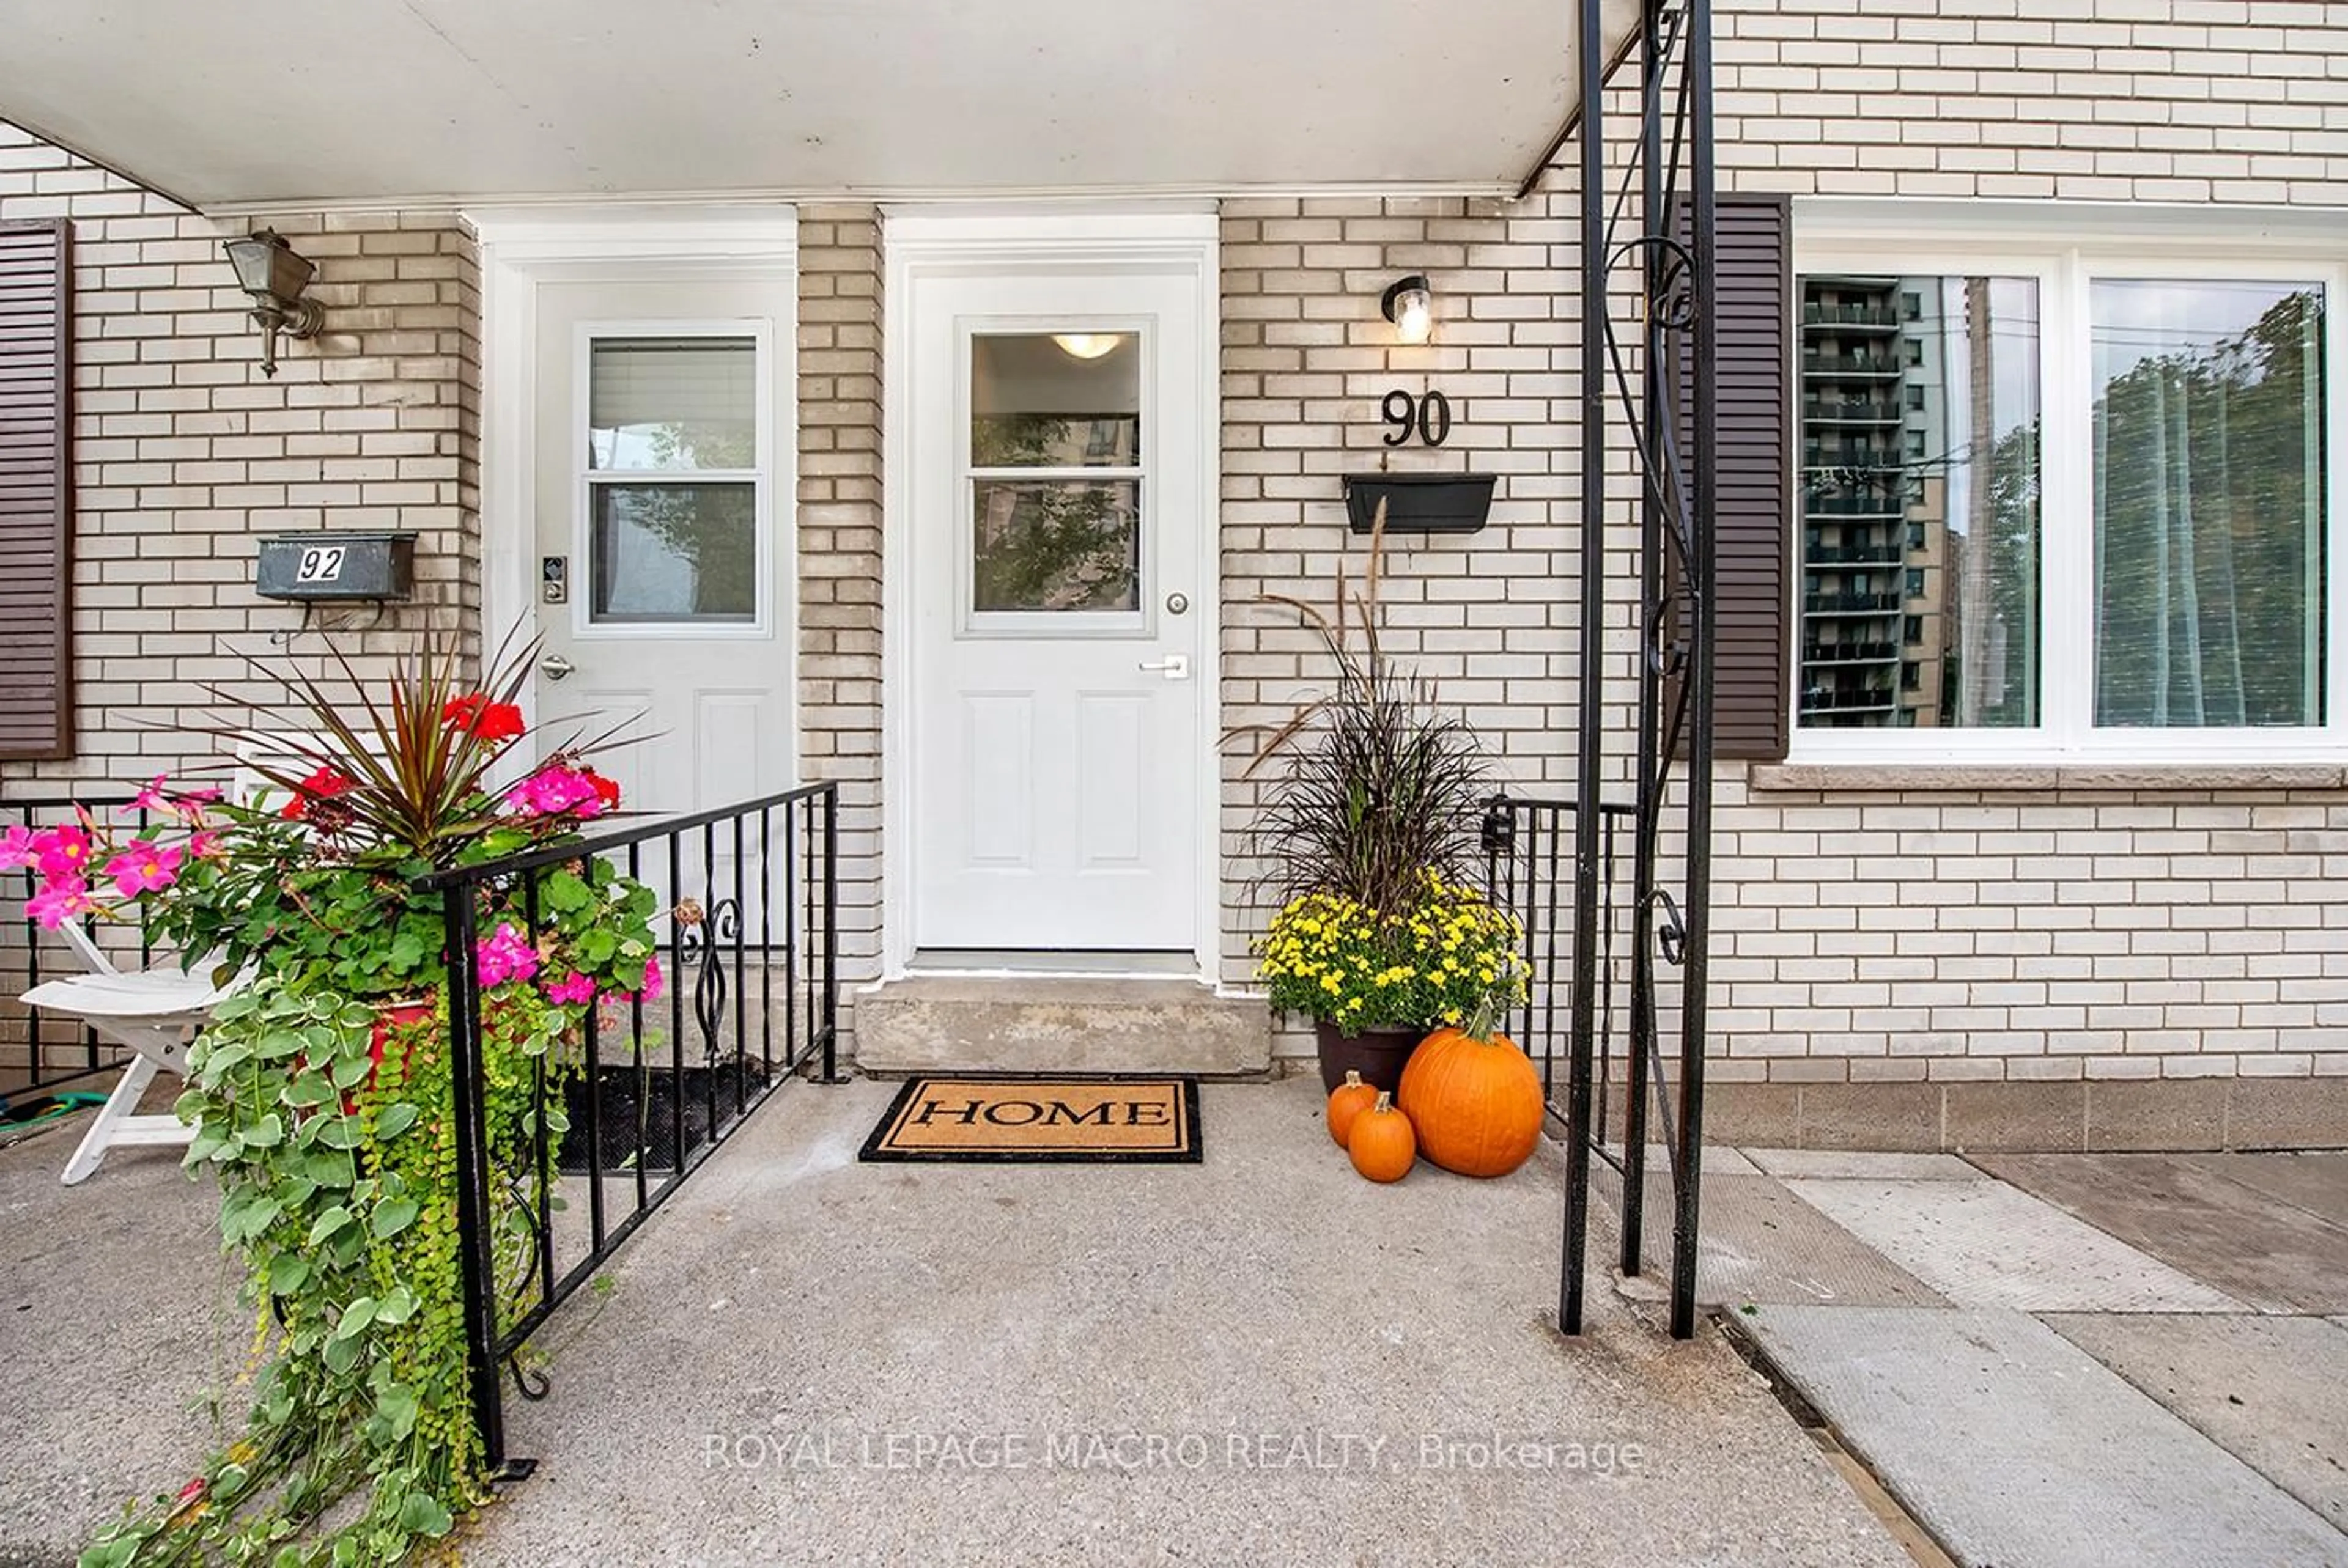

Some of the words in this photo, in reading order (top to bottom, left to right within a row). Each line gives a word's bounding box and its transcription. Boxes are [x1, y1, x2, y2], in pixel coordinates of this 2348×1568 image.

[1382, 390, 1450, 446] 90
[301, 550, 341, 579] 92
[910, 1100, 1171, 1127] HOME
